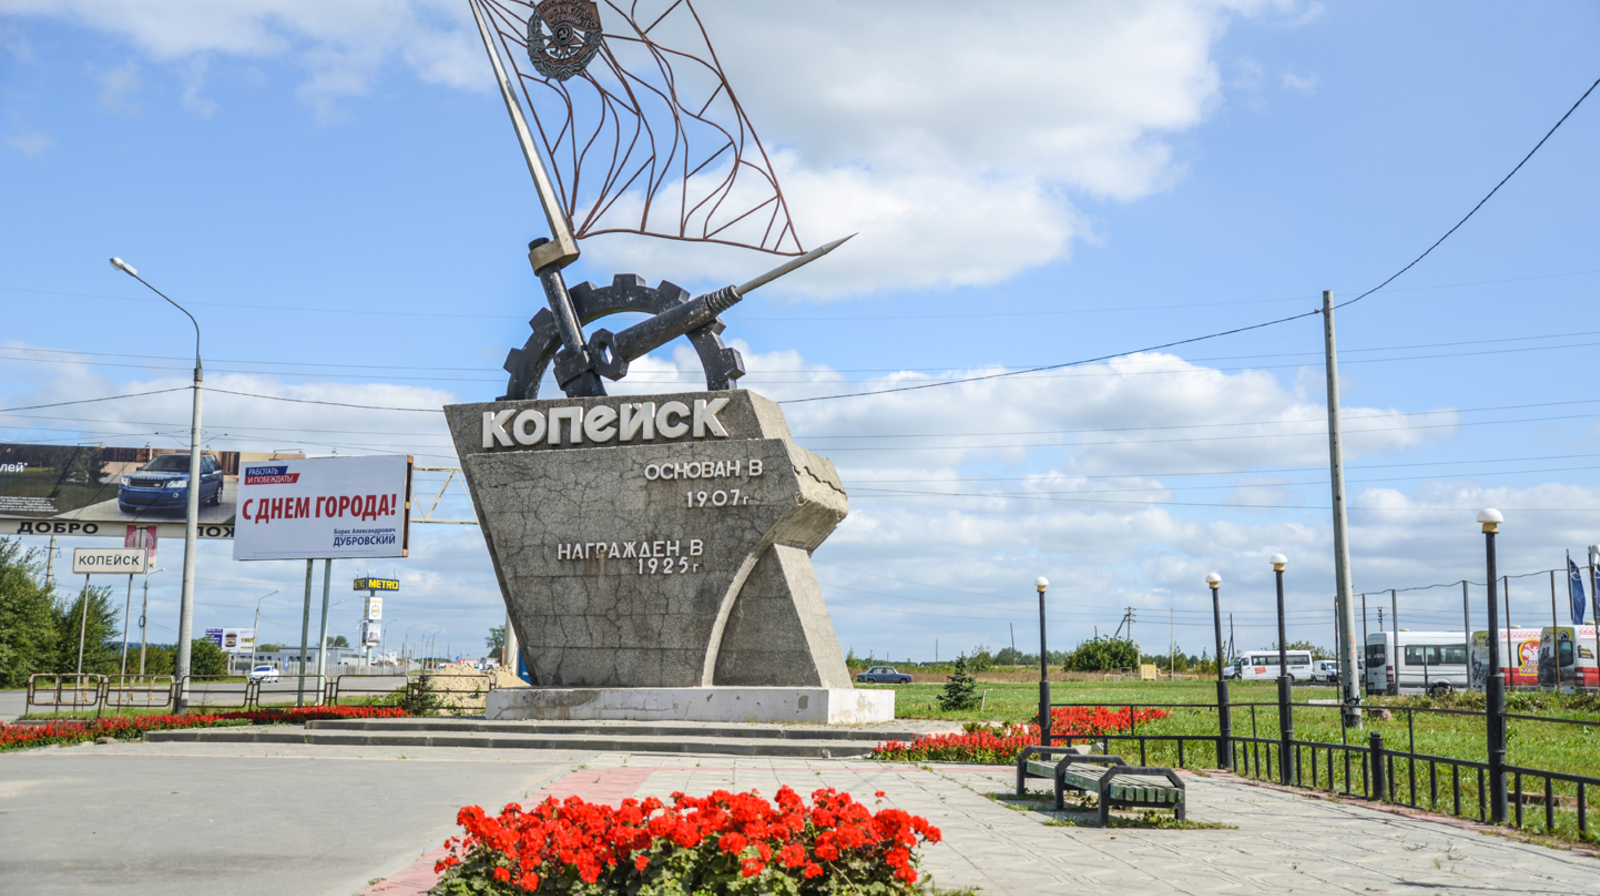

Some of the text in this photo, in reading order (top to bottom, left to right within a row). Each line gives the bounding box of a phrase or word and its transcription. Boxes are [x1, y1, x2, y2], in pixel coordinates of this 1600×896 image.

[644, 459, 763, 480] ОСНОВАН В
[242, 493, 397, 524] С ДНЕМ ГОРОДА!
[17, 521, 99, 535] ДОБРО
[333, 533, 396, 548] ДУБРОВСКИЙ
[557, 539, 704, 560] НАГРАЖДЕН В
[78, 553, 140, 566] КОПЕЙСК
[368, 578, 399, 590] METRO
